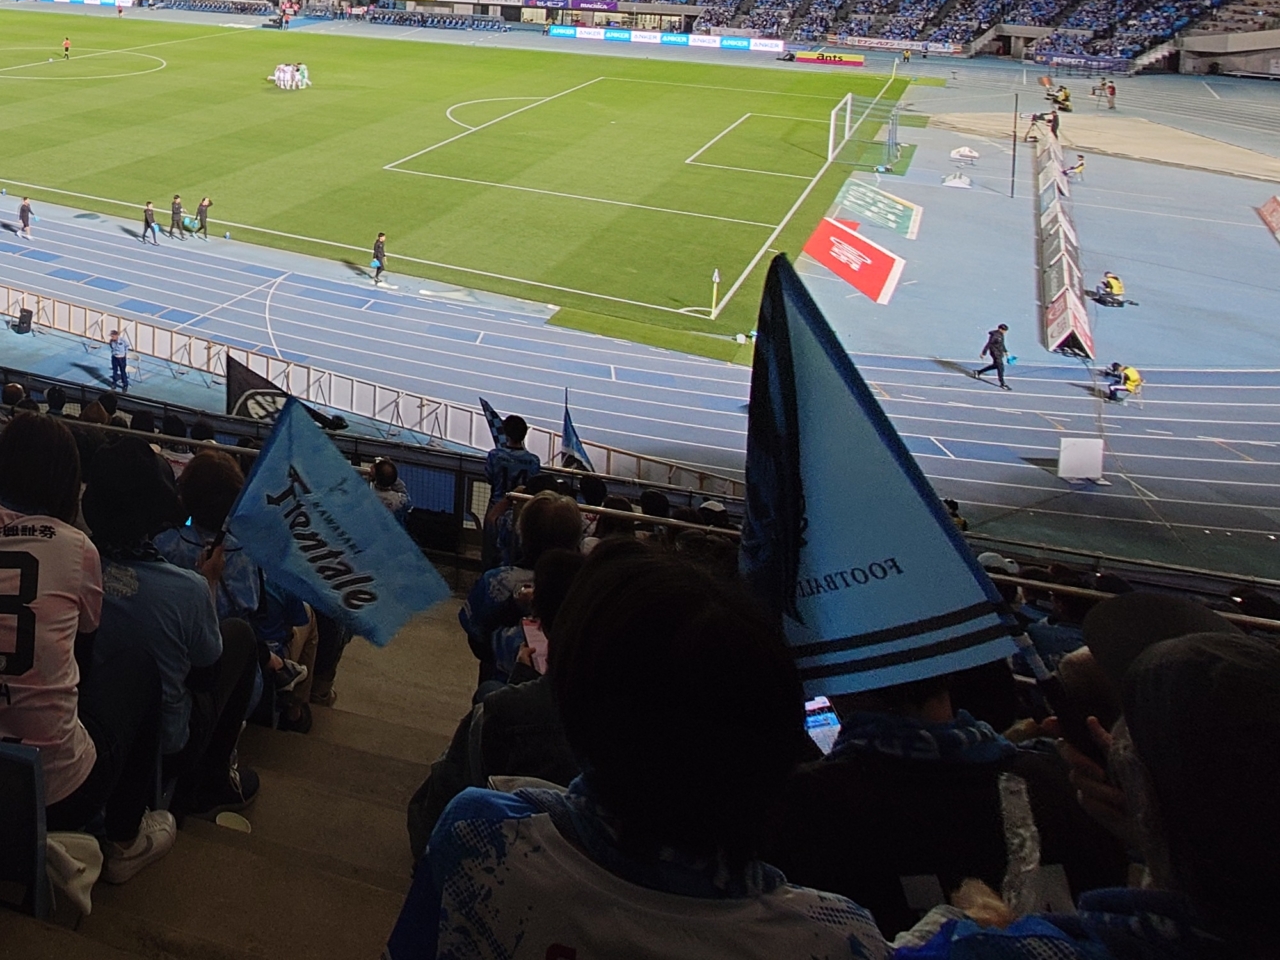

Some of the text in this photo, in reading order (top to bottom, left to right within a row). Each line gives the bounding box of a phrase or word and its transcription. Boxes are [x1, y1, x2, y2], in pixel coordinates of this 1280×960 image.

[578, 29, 602, 37] ANKER
[605, 31, 630, 39] ANKER
[633, 33, 658, 41] ANKER
[662, 35, 687, 43] ANKER
[691, 37, 717, 45] ANKER
[722, 39, 748, 47] ANKER
[753, 41, 780, 49] ANKER
